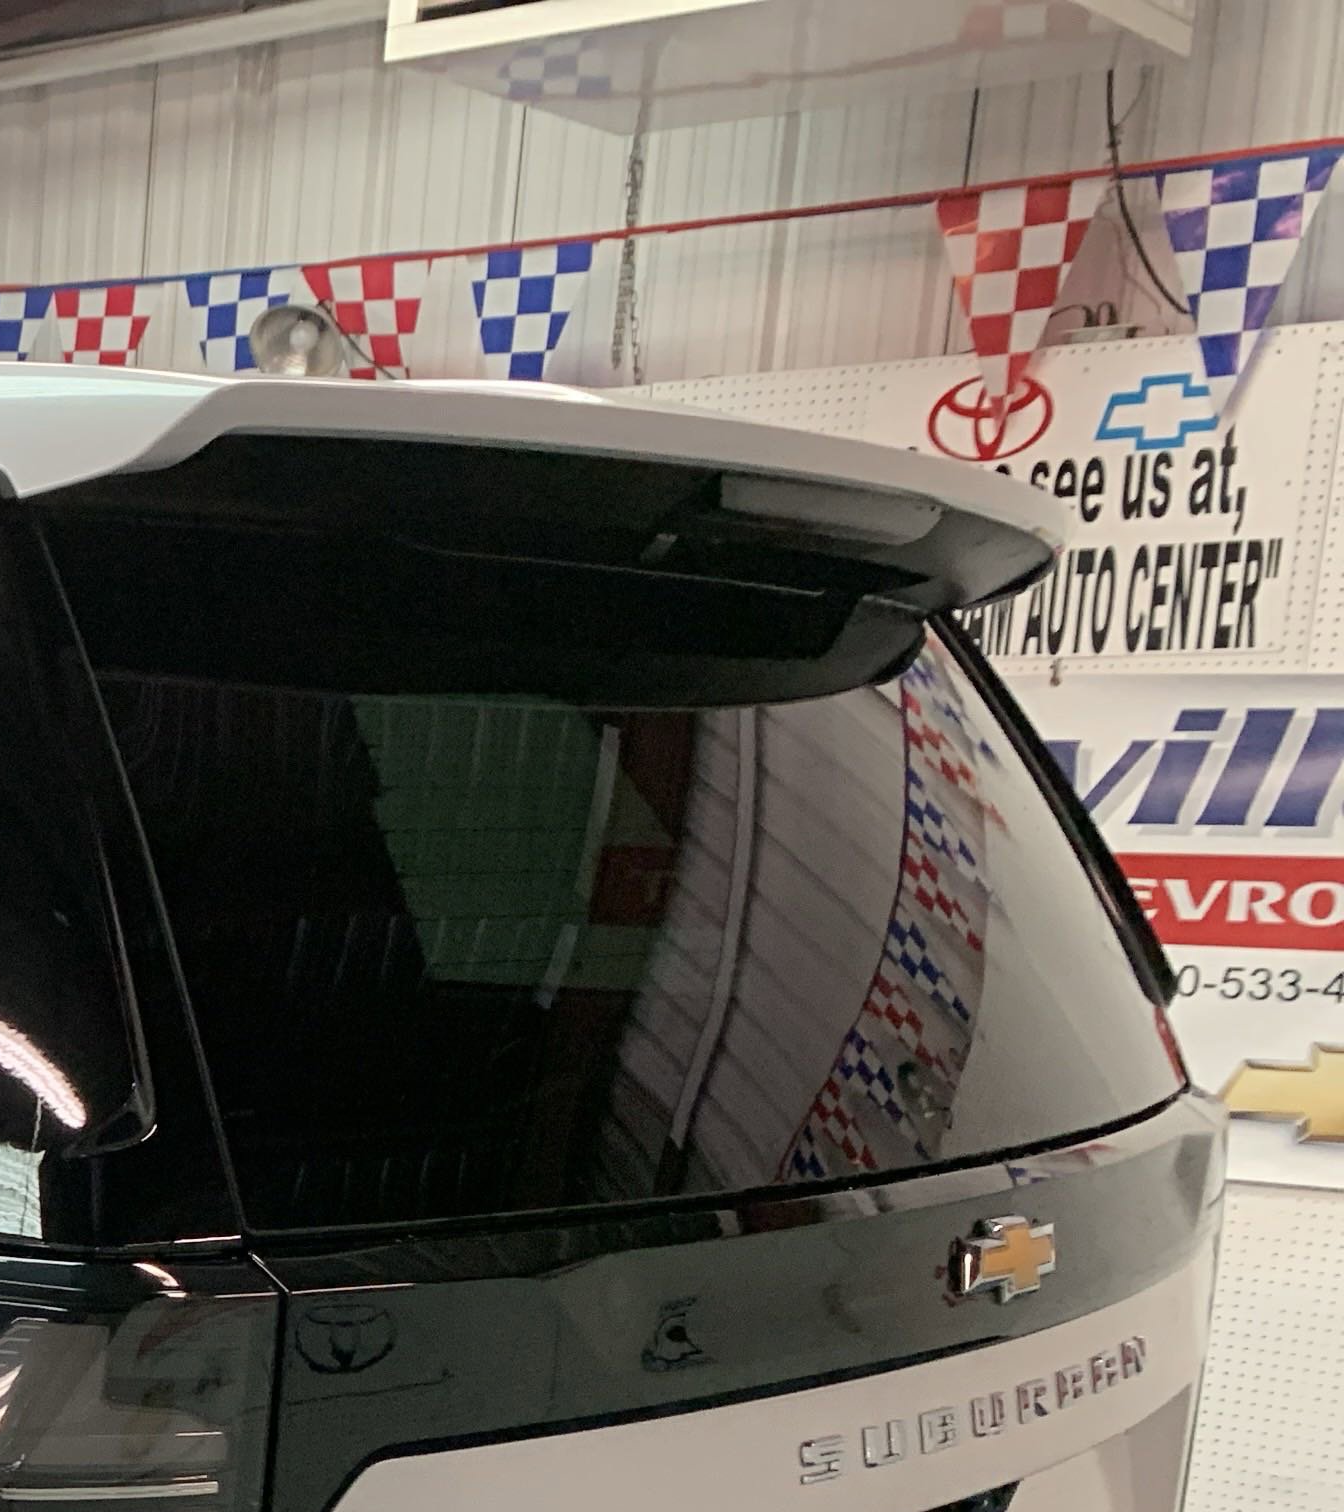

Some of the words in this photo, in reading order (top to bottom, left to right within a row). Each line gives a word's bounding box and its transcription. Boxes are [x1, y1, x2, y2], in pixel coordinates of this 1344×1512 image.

[1122, 451, 1174, 520] us
[1188, 424, 1247, 534] at,
[1020, 546, 1118, 656] AUTO
[1045, 707, 1344, 828] vill
